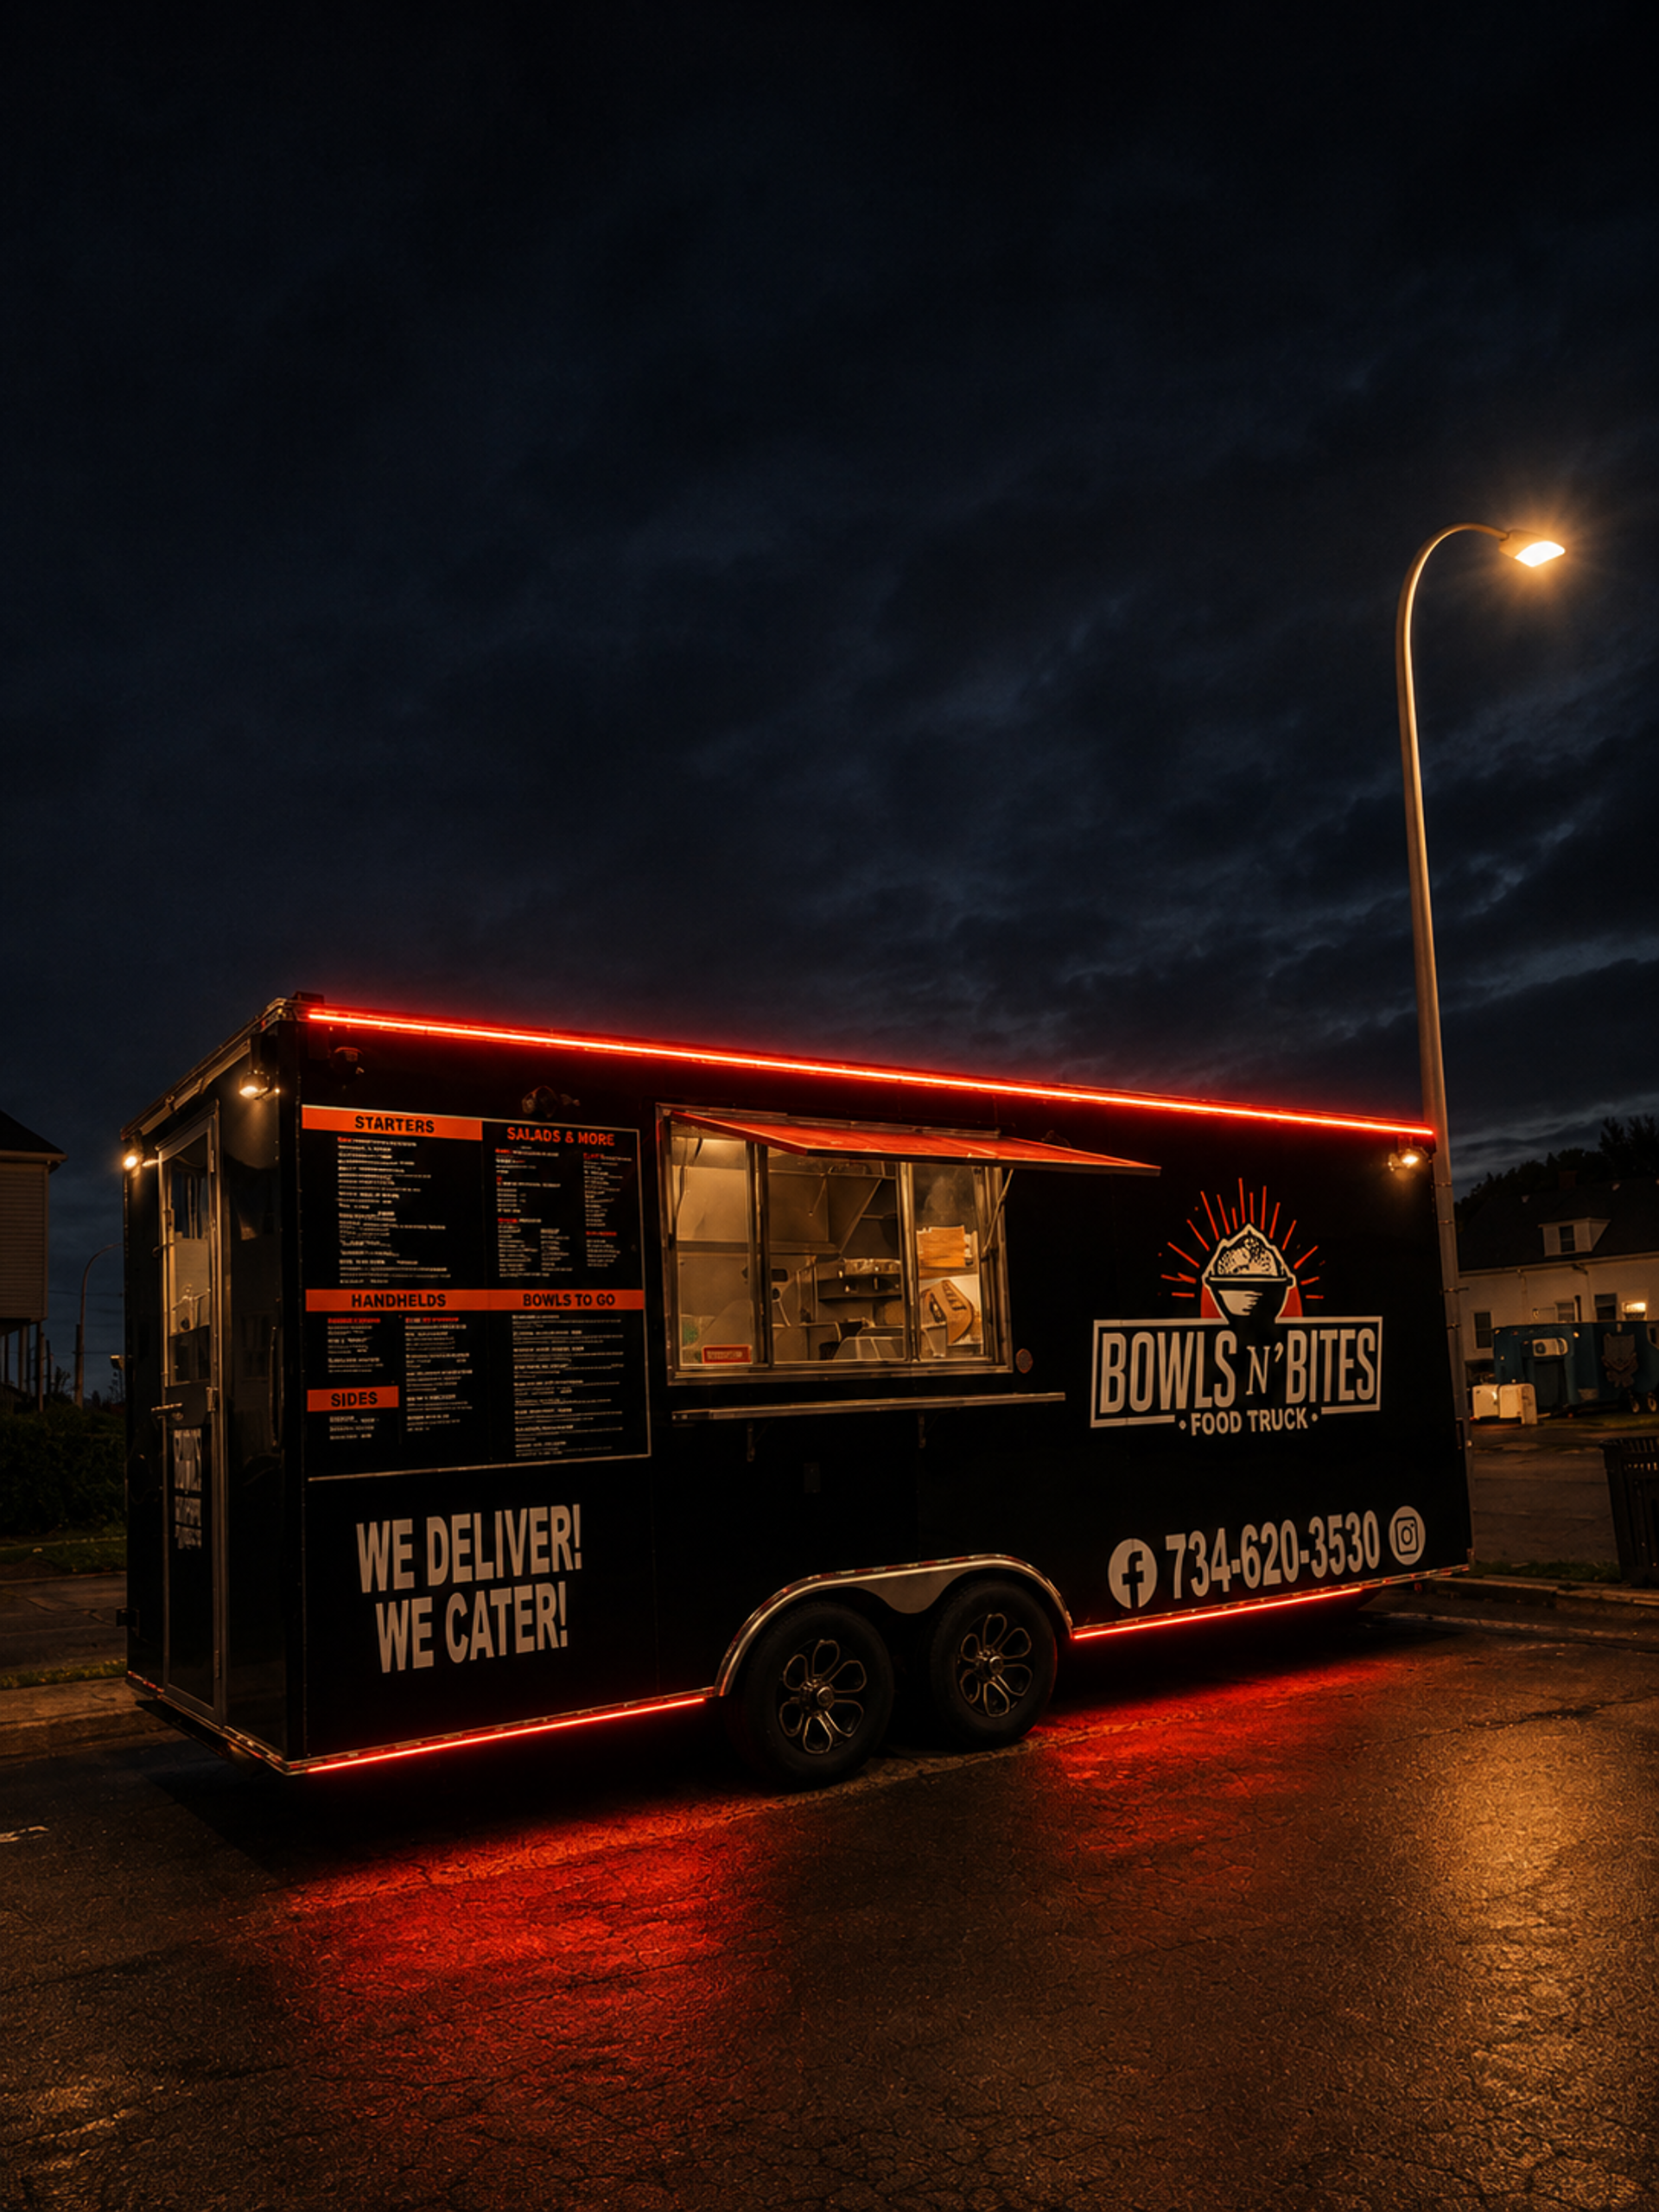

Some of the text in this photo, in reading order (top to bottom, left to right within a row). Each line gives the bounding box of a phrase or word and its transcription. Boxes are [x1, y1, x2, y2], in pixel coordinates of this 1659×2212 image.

[355, 1116, 435, 1133] STARTERS
[507, 1127, 615, 1147] SALADS & MORE
[352, 1294, 447, 1307] HANDHELDS
[524, 1293, 615, 1306] BOWLS TO GO
[1102, 1331, 1238, 1414] BOWLS
[1285, 1326, 1377, 1406] BITES
[331, 1391, 378, 1408] SIDES
[1190, 1406, 1308, 1438] FOOD TRUCK
[355, 1503, 583, 1594] WE DELIVER!
[1166, 1509, 1380, 1599] 734-620-3530
[375, 1580, 569, 1675] WE CATER!
